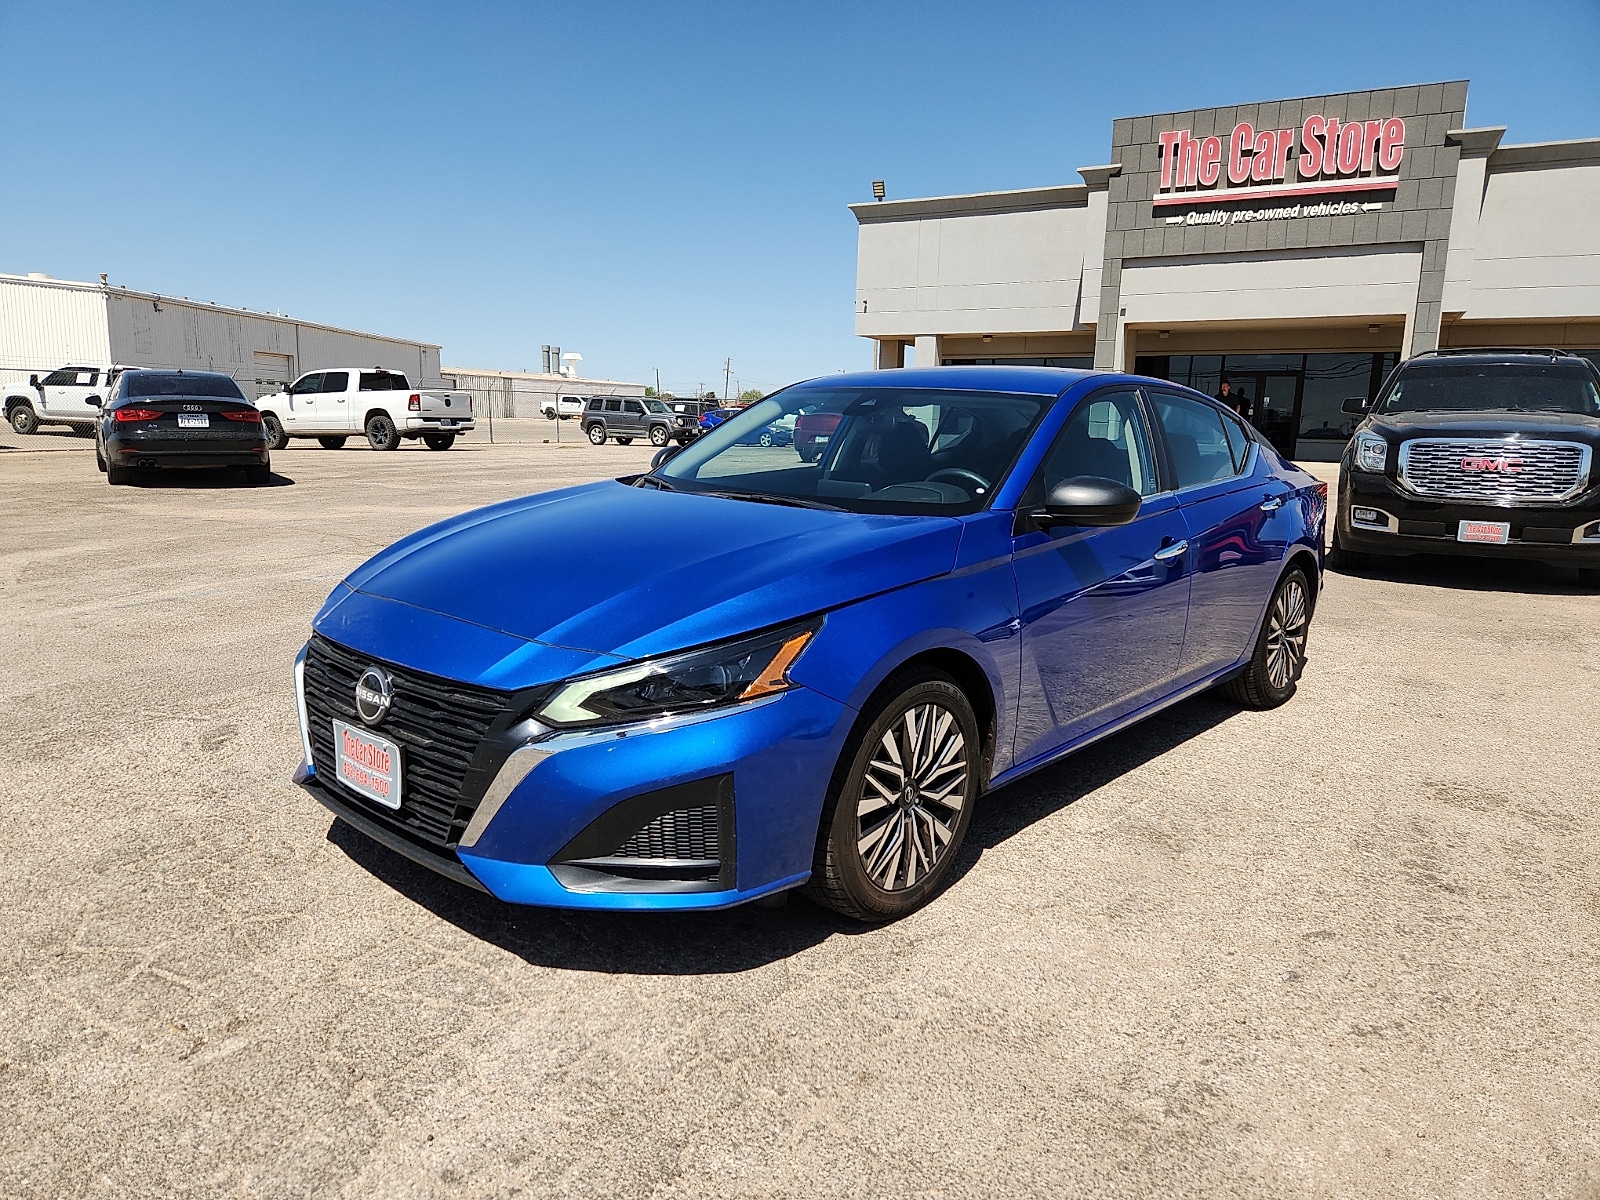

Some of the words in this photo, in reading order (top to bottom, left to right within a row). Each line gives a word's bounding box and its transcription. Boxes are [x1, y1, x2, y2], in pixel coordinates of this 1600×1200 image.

[1158, 129, 1222, 189] The
[1227, 121, 1295, 184] Car
[1298, 114, 1406, 178] Store
[1185, 209, 1231, 227] Quality
[1231, 203, 1300, 225] pre-owned
[1303, 200, 1359, 217] vehicles
[1460, 457, 1524, 473] GMC
[354, 737, 368, 764] Car
[367, 742, 391, 773] Store
